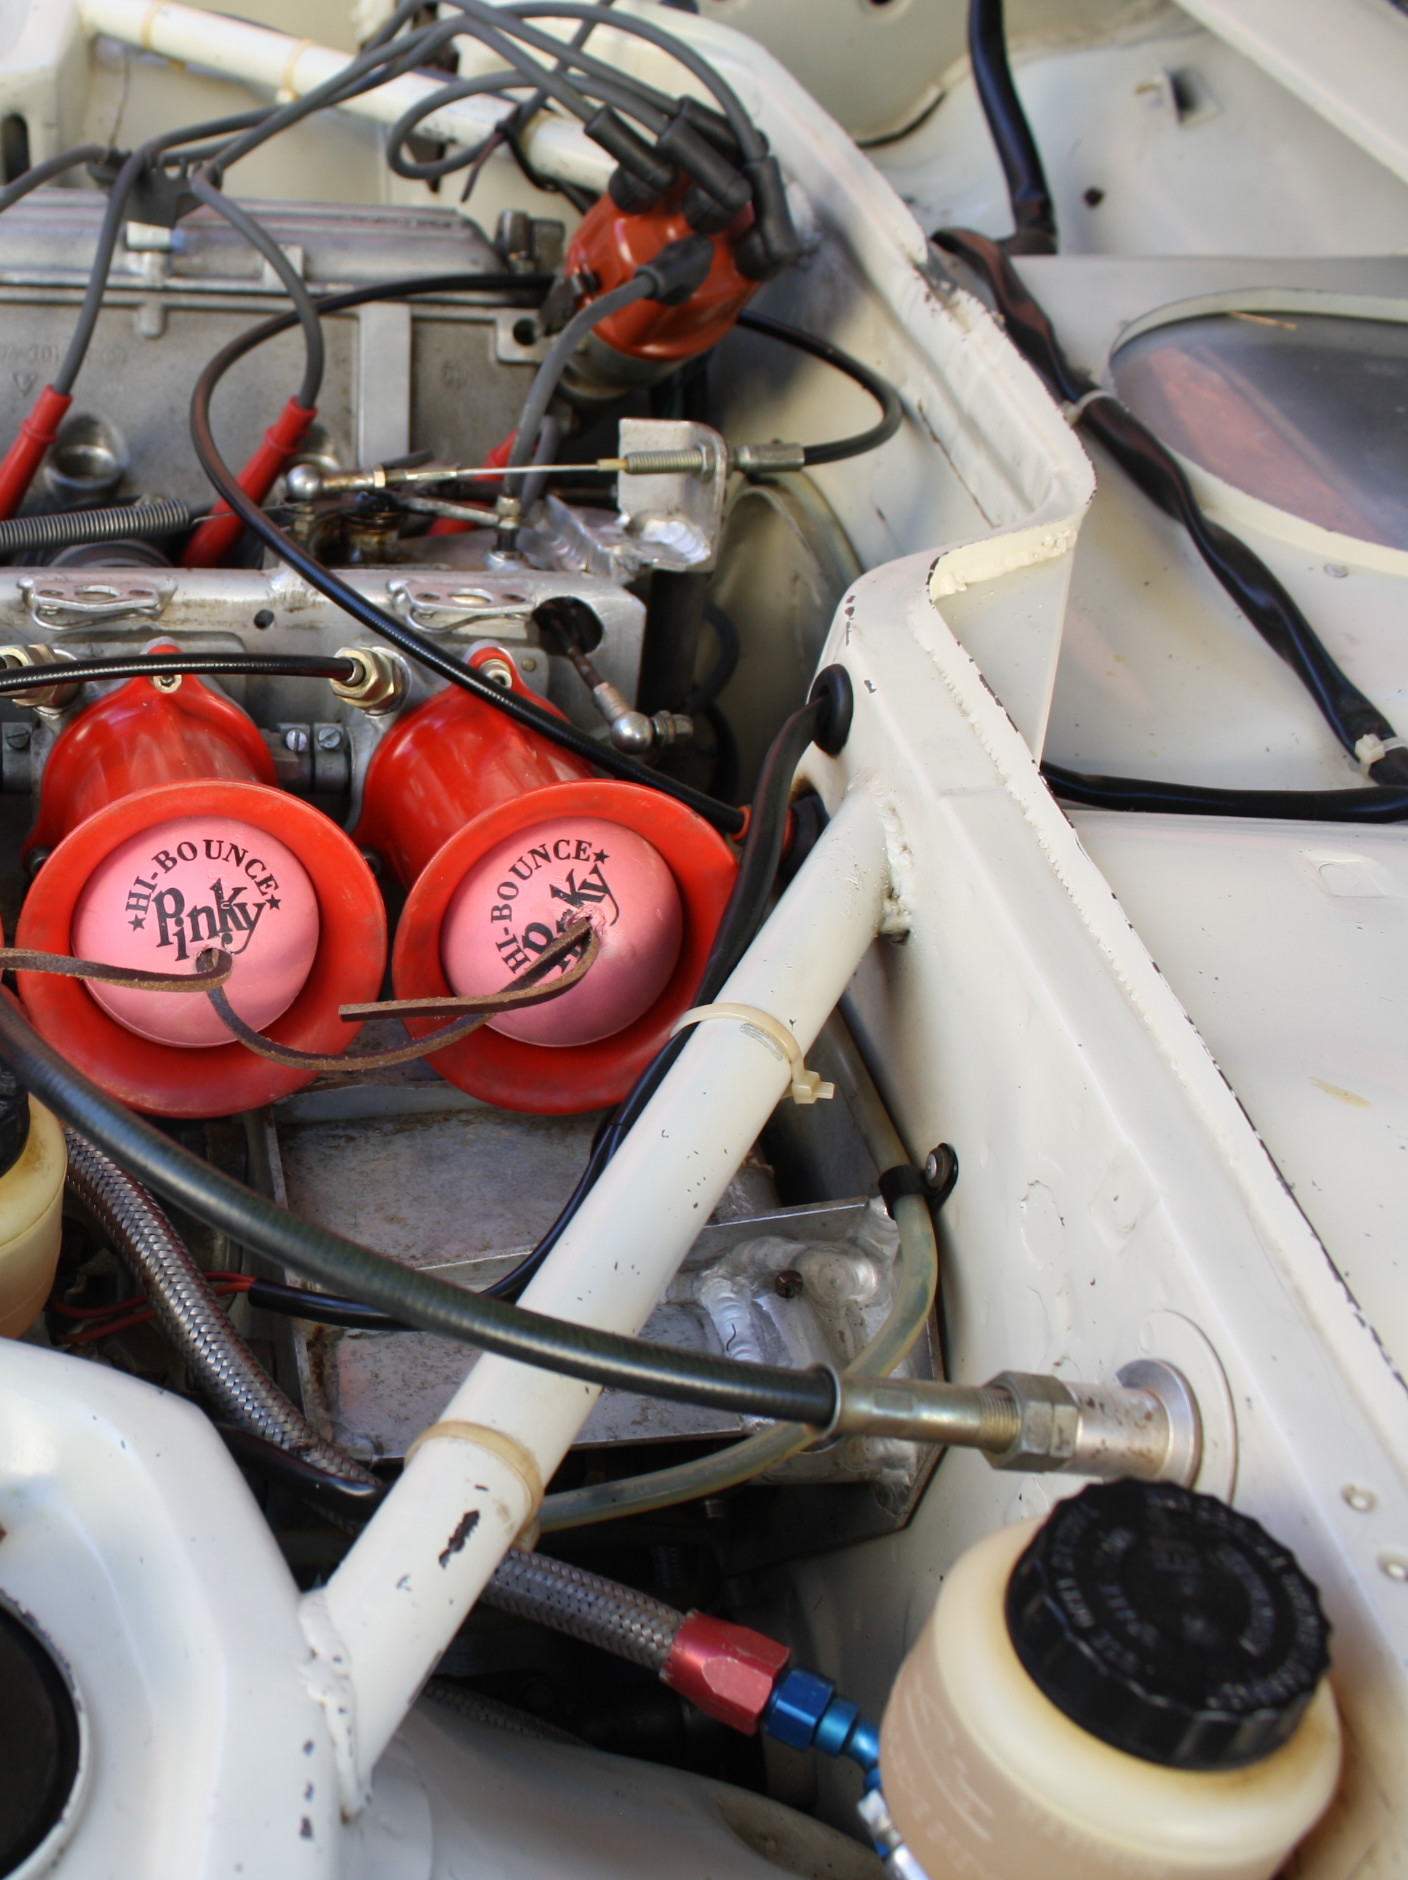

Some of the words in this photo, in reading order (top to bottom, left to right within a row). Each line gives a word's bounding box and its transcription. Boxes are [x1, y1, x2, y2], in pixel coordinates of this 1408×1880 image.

[126, 839, 279, 914] HI-BOUNCE
[152, 878, 267, 961] Pinky
[491, 839, 592, 974] HI-BOUNCE
[522, 863, 619, 973] Pky
